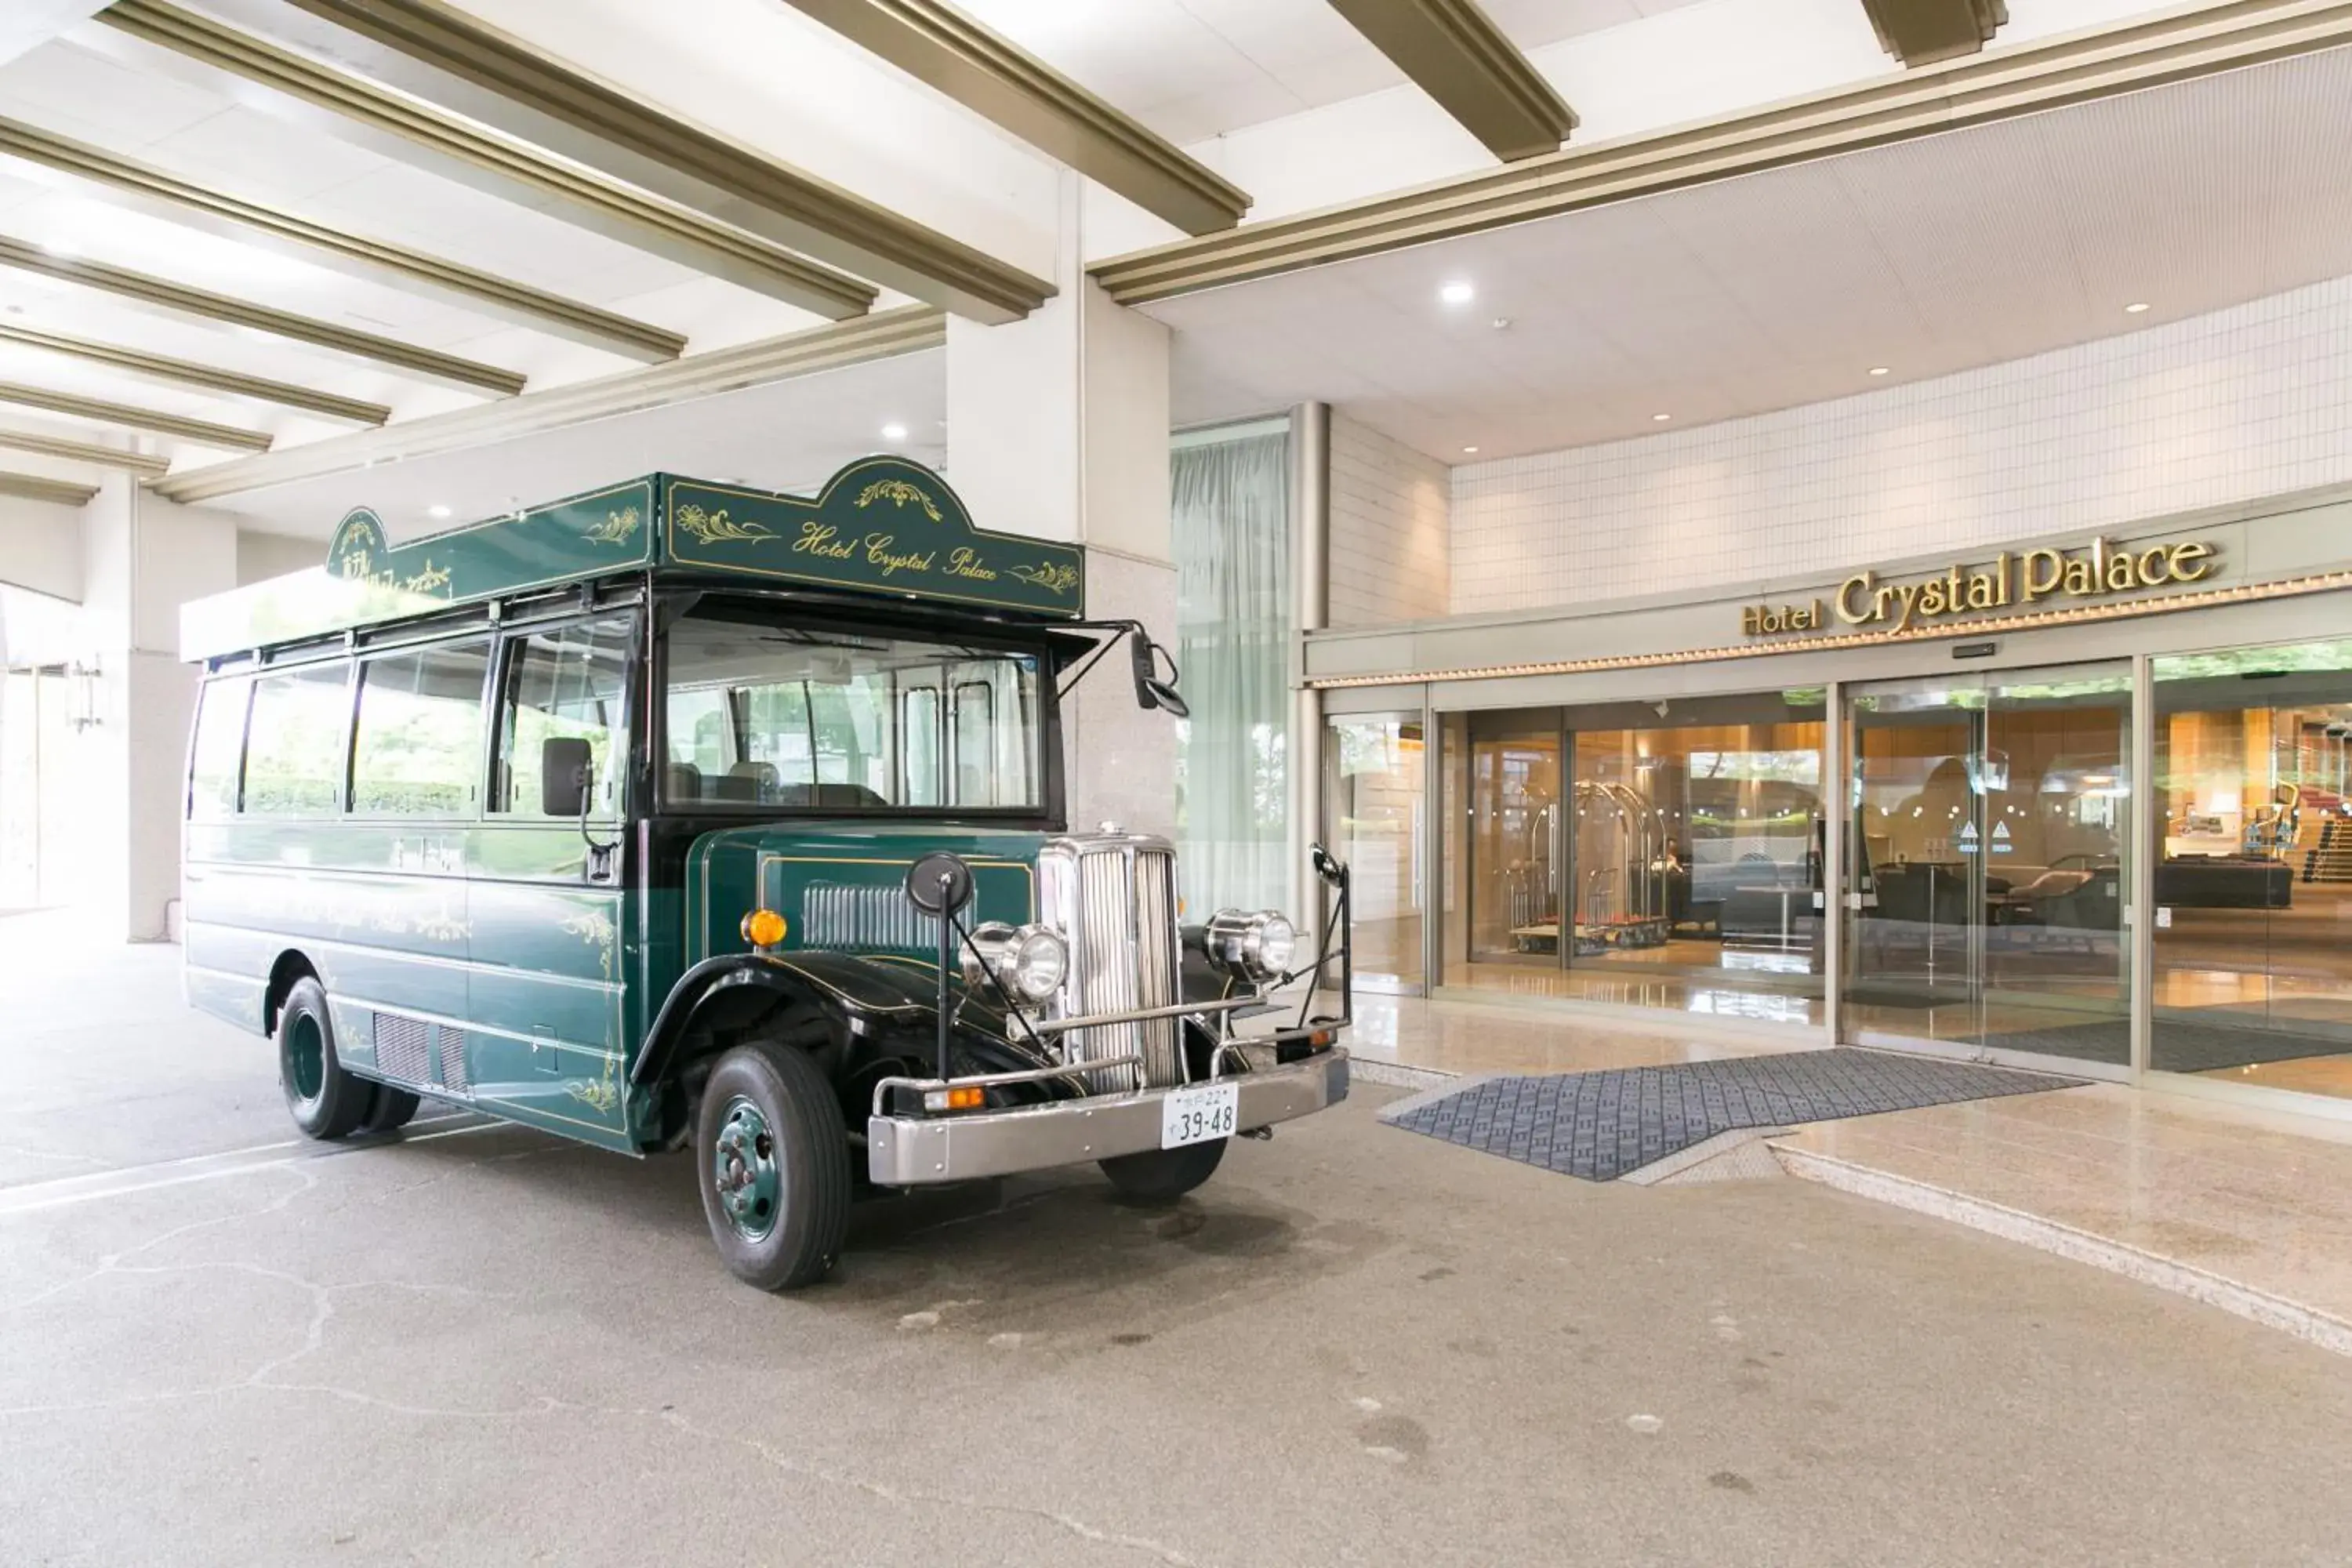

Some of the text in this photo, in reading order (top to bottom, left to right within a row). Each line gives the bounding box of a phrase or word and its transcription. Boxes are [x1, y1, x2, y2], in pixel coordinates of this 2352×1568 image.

[793, 521, 997, 582] Hotel Crystal Palace
[1741, 536, 2212, 637] Hotel Crystal Palace
[1180, 1105, 1232, 1141] 39-48
